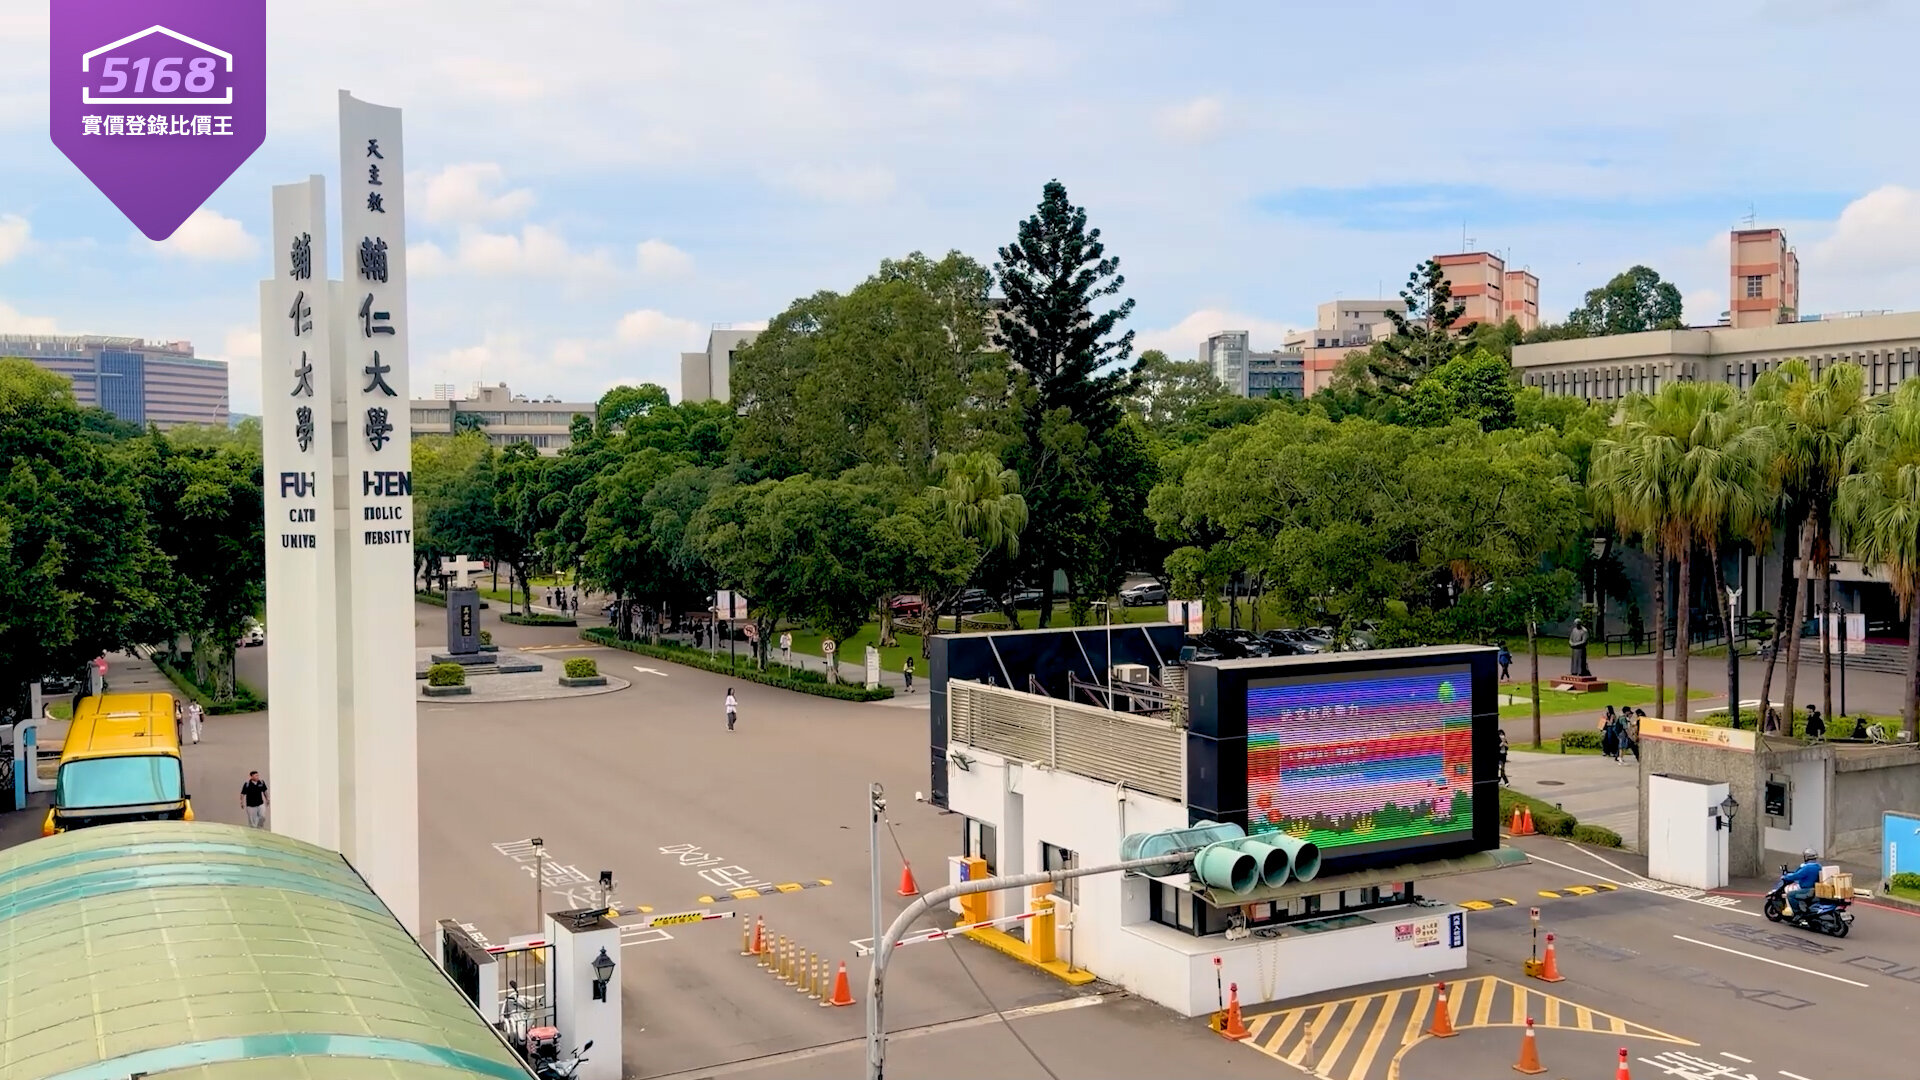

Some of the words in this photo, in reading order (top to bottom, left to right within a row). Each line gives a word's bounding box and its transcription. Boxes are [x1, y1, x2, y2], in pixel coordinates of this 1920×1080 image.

[366, 138, 386, 214] 天主教
[359, 236, 398, 452] 輔仁大學
[824, 642, 834, 651] 20
